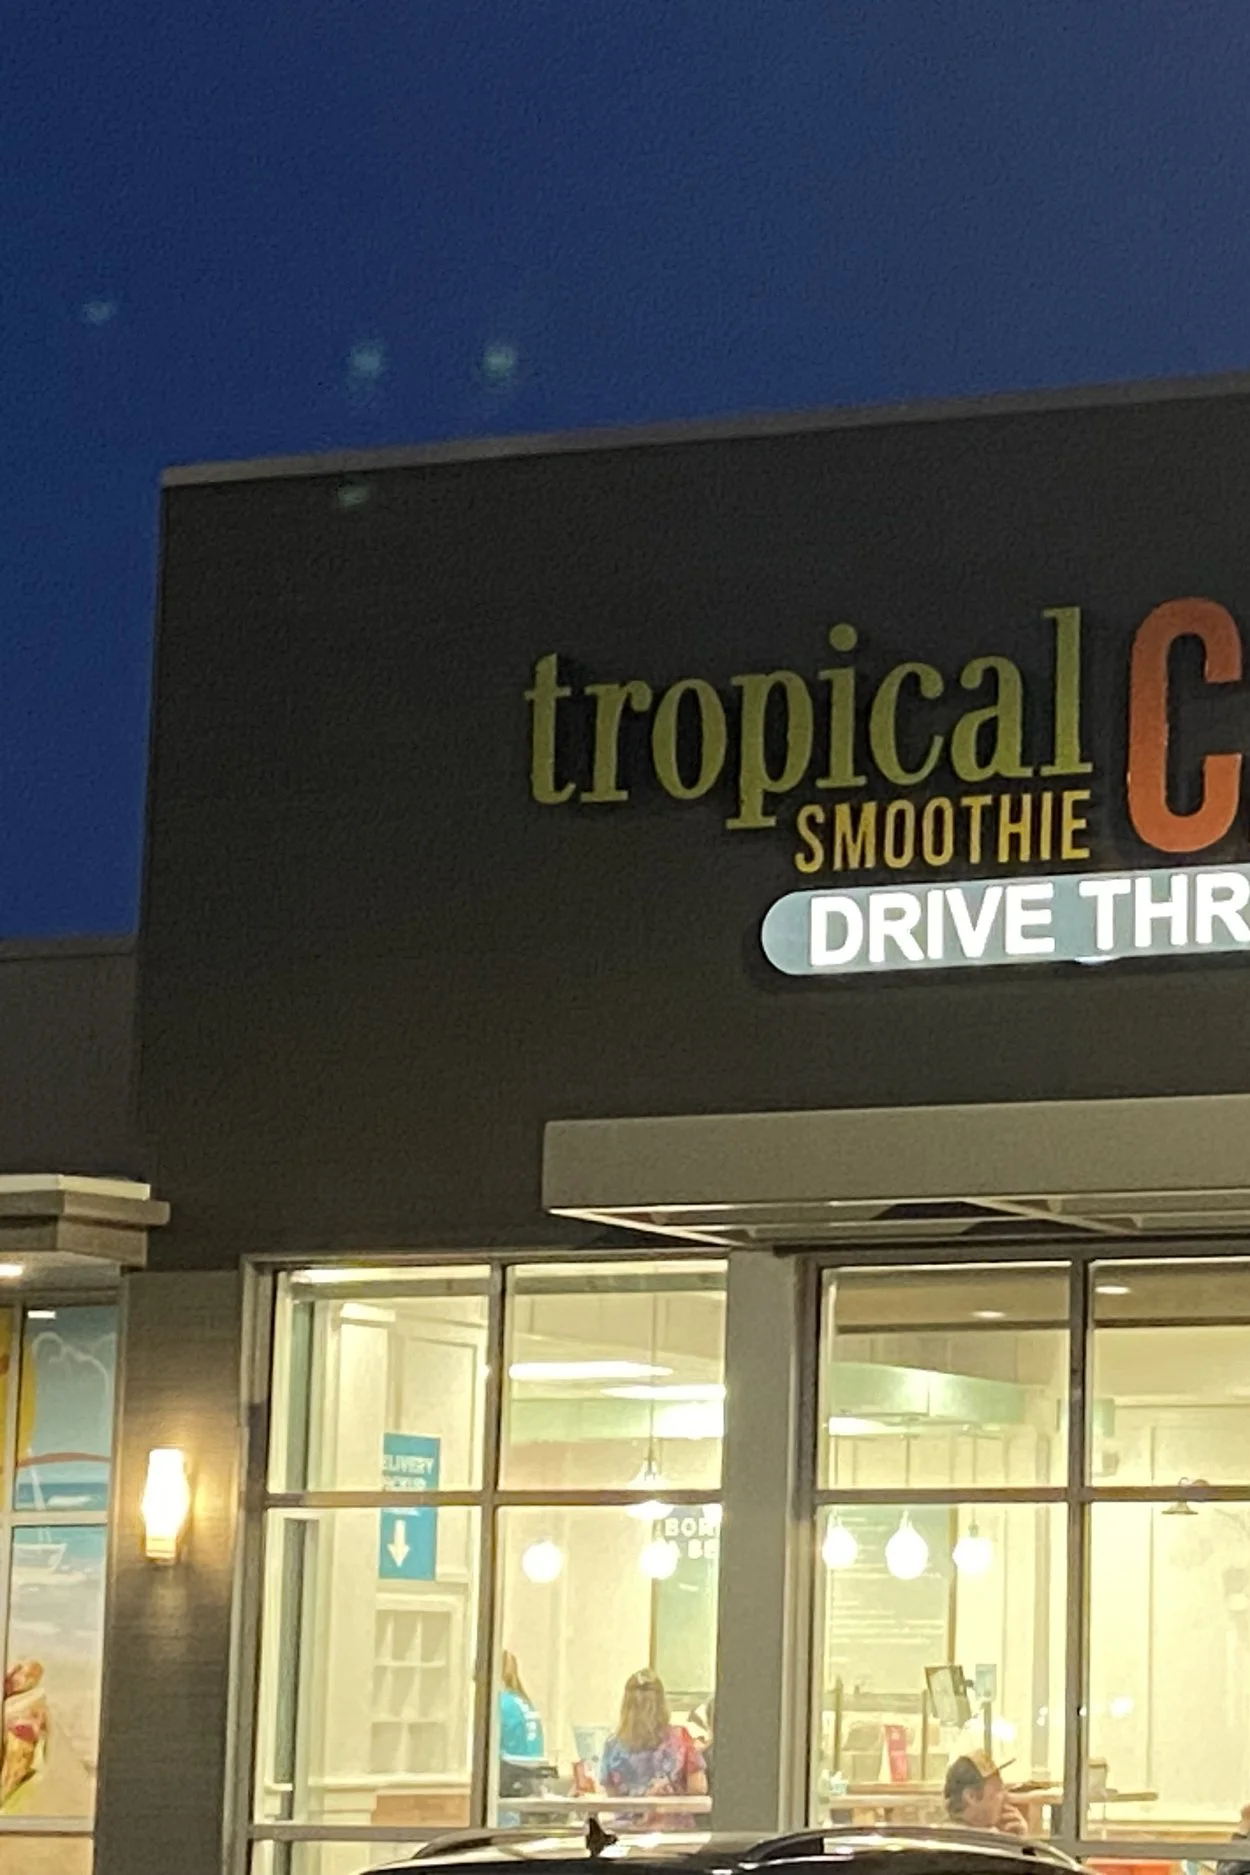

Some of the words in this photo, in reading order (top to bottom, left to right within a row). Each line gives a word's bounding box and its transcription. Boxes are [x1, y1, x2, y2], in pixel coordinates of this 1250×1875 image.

[524, 606, 1093, 830] tropical
[795, 789, 1091, 873] SMOOTHIE
[809, 882, 1056, 967] DRIVE
